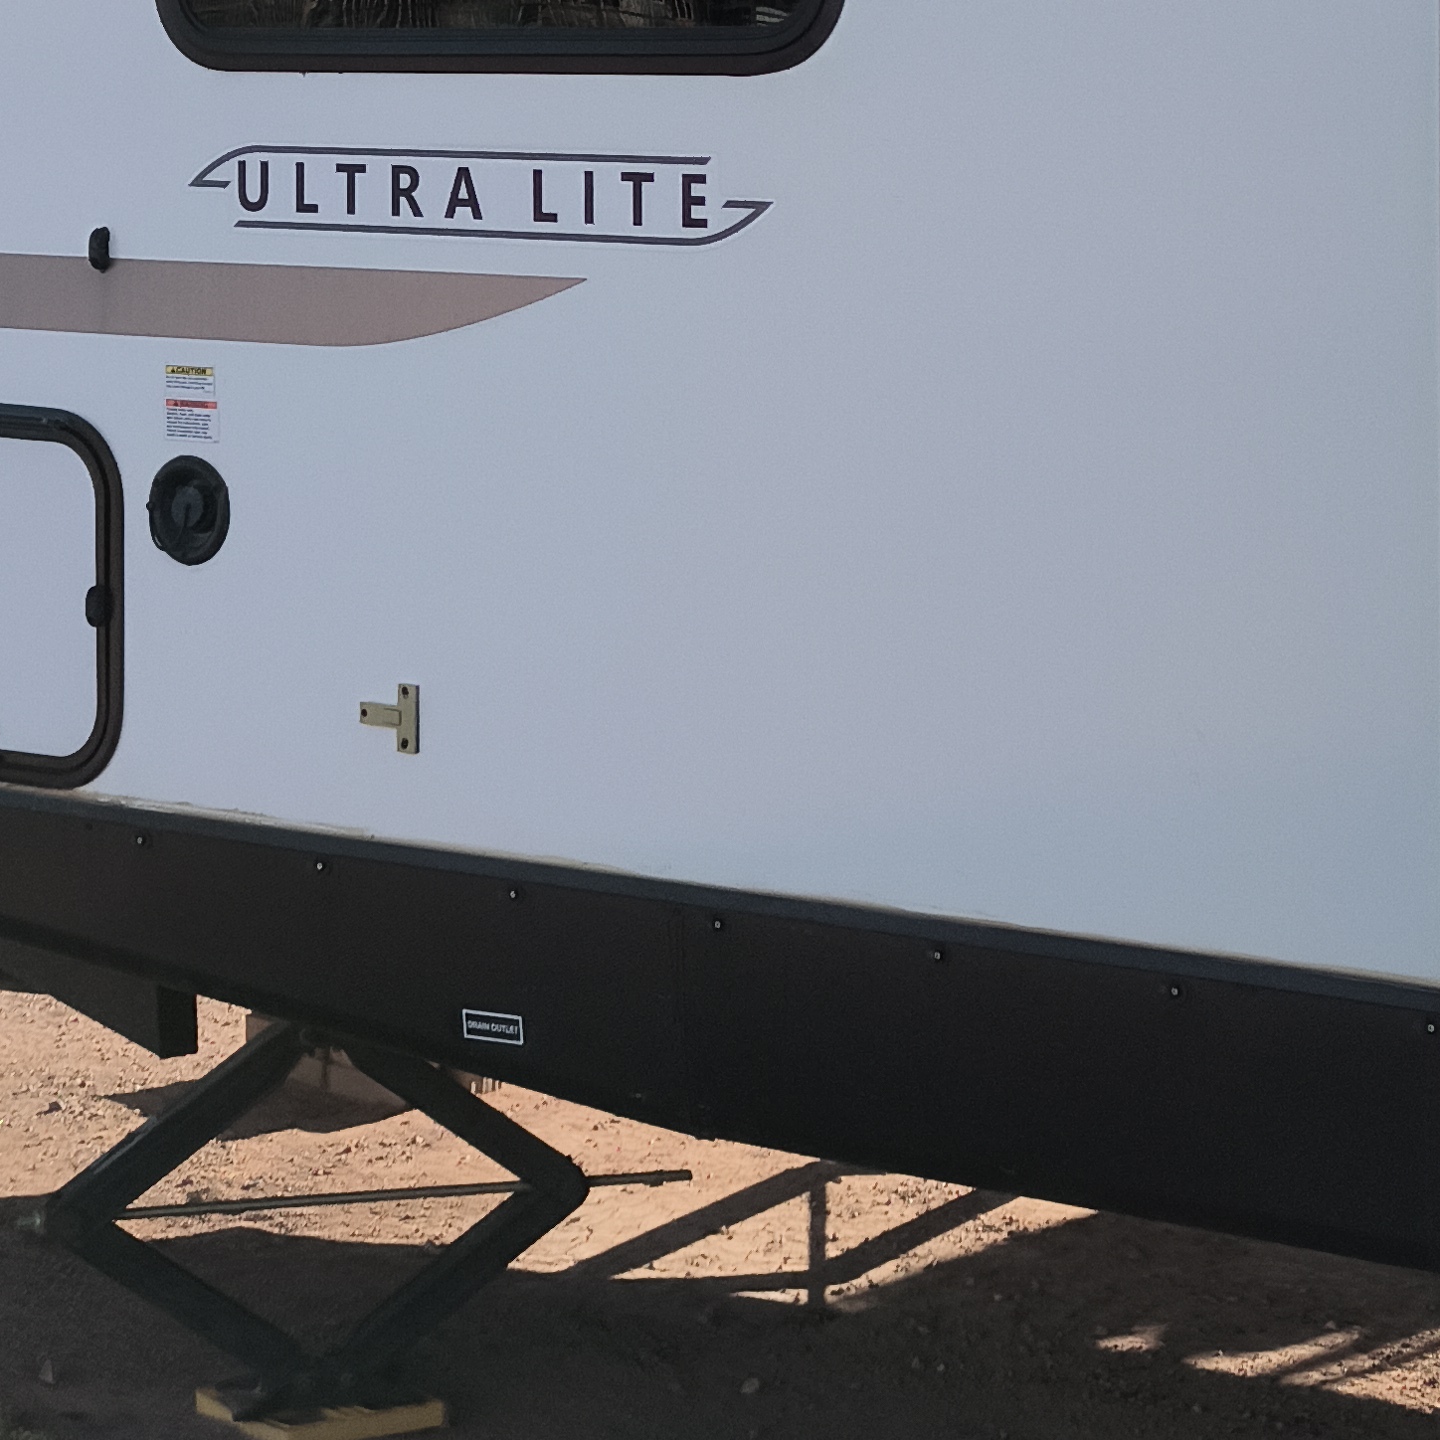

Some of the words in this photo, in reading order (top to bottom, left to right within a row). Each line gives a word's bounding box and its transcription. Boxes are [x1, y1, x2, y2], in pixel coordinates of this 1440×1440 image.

[236, 159, 484, 221] ULTRA
[531, 168, 709, 229] LITE
[176, 366, 207, 375] CAUTION
